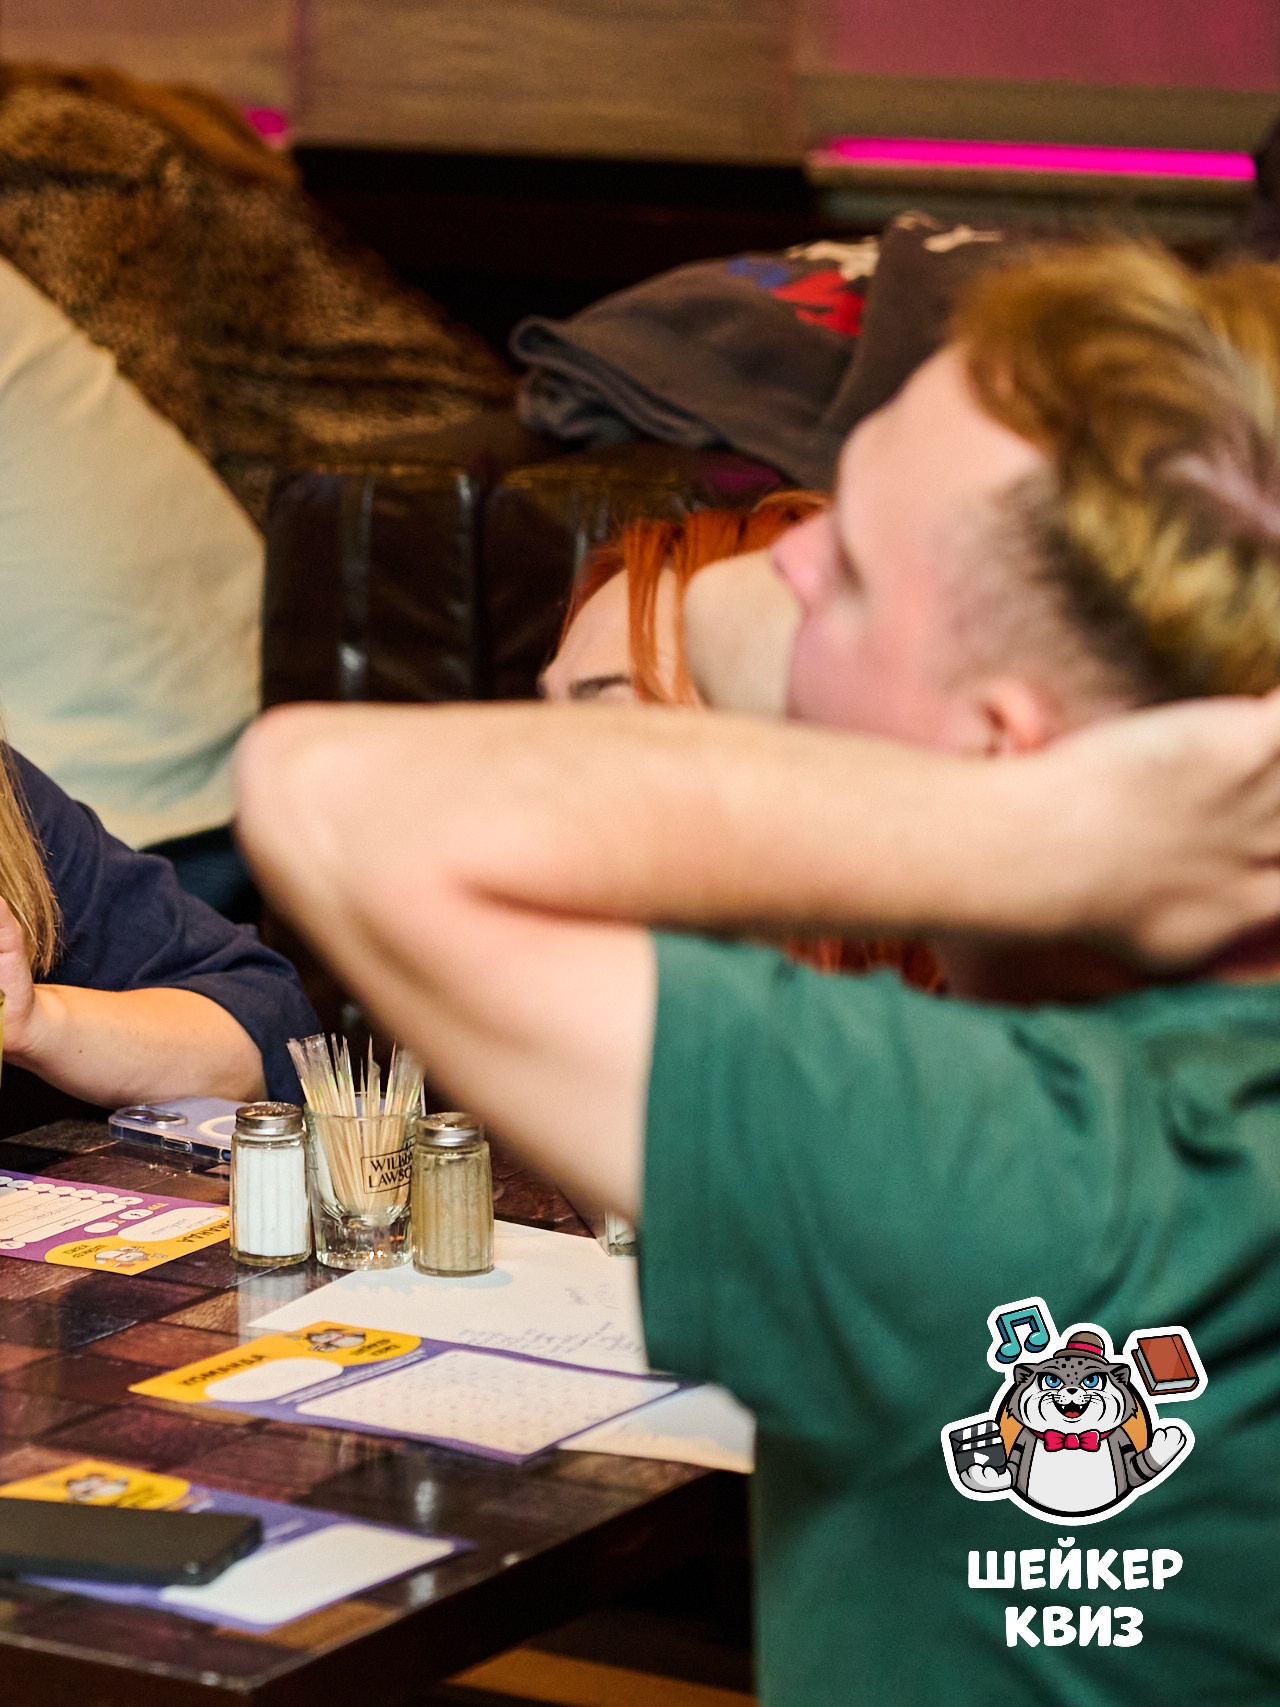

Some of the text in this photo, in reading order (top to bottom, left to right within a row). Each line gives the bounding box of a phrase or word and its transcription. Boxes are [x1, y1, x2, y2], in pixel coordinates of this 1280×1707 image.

[368, 1164, 413, 1188] LAWSO
[175, 1219, 231, 1244] МАНДА
[181, 1353, 267, 1387] КОМАНДА
